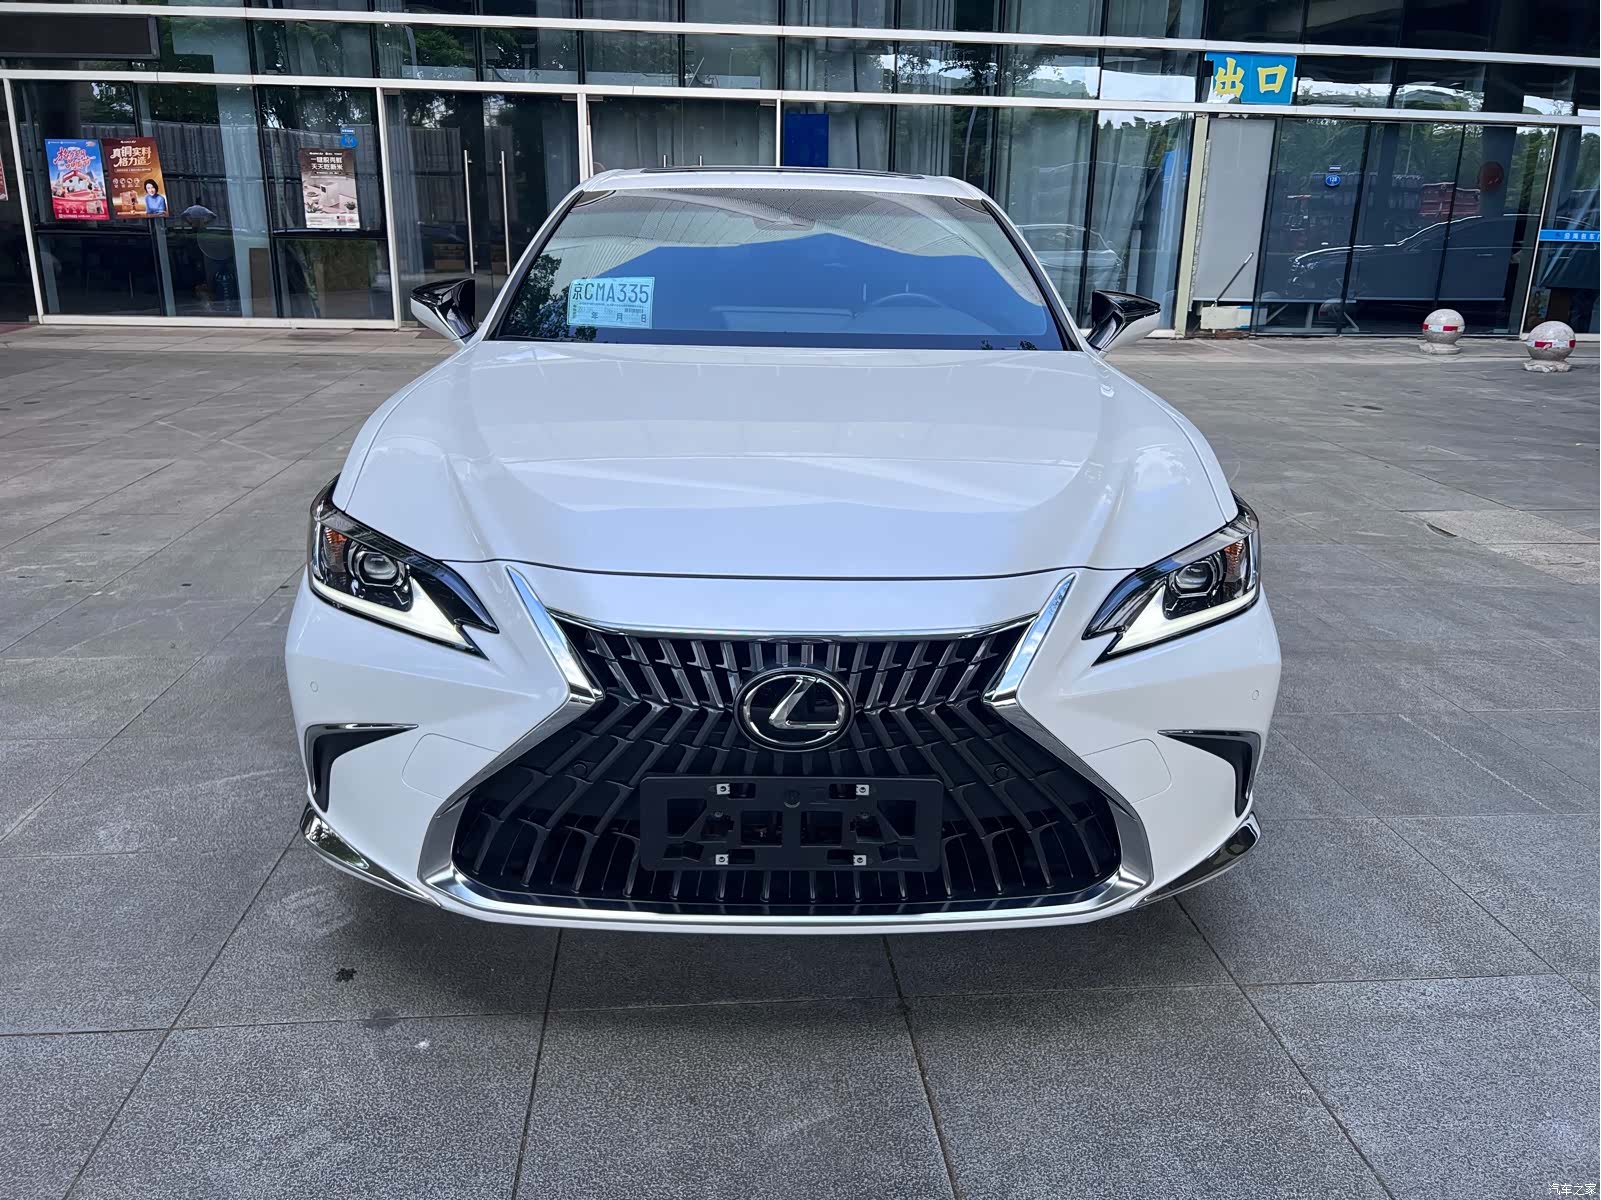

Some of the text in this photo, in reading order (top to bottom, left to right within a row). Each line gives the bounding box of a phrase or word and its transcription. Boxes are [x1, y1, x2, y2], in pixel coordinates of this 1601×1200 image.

[1215, 57, 1288, 97] 出口
[113, 156, 152, 167] 格力造
[572, 282, 650, 304] 京CMA335
[591, 311, 647, 323] 年 月 日
